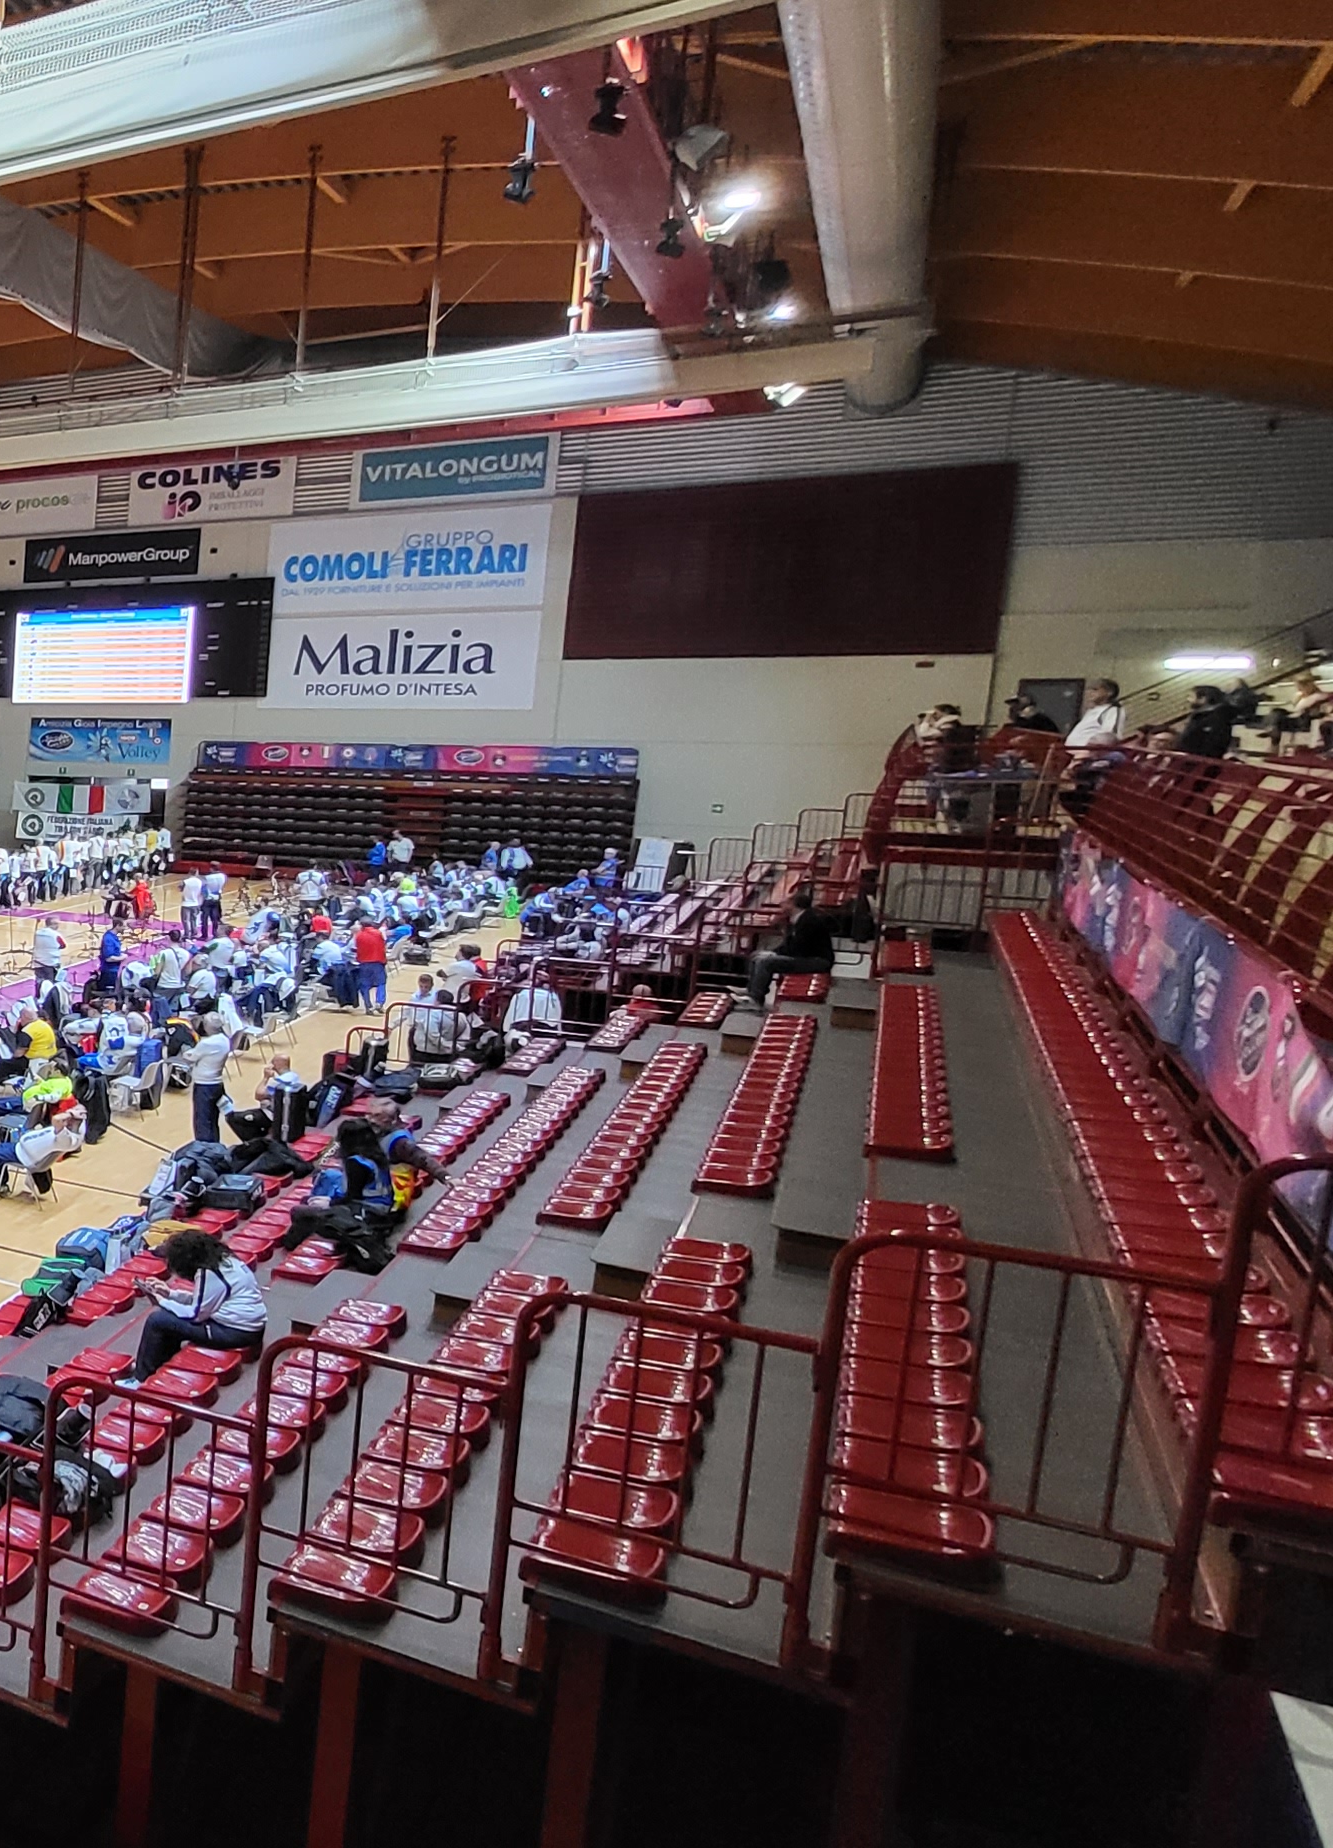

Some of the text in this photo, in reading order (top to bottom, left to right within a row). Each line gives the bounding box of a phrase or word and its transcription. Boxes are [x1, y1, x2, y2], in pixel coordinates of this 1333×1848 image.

[137, 459, 281, 490] COLINES
[366, 451, 546, 483] VITALONGUM
[406, 530, 494, 549] GRUPPO
[68, 547, 191, 567] ManpowerGroup
[284, 543, 529, 583] COMOLI FERRARI
[293, 628, 496, 676] Malizia
[305, 682, 478, 696] PROFUMO D'INTESA
[117, 743, 161, 761] Volley
